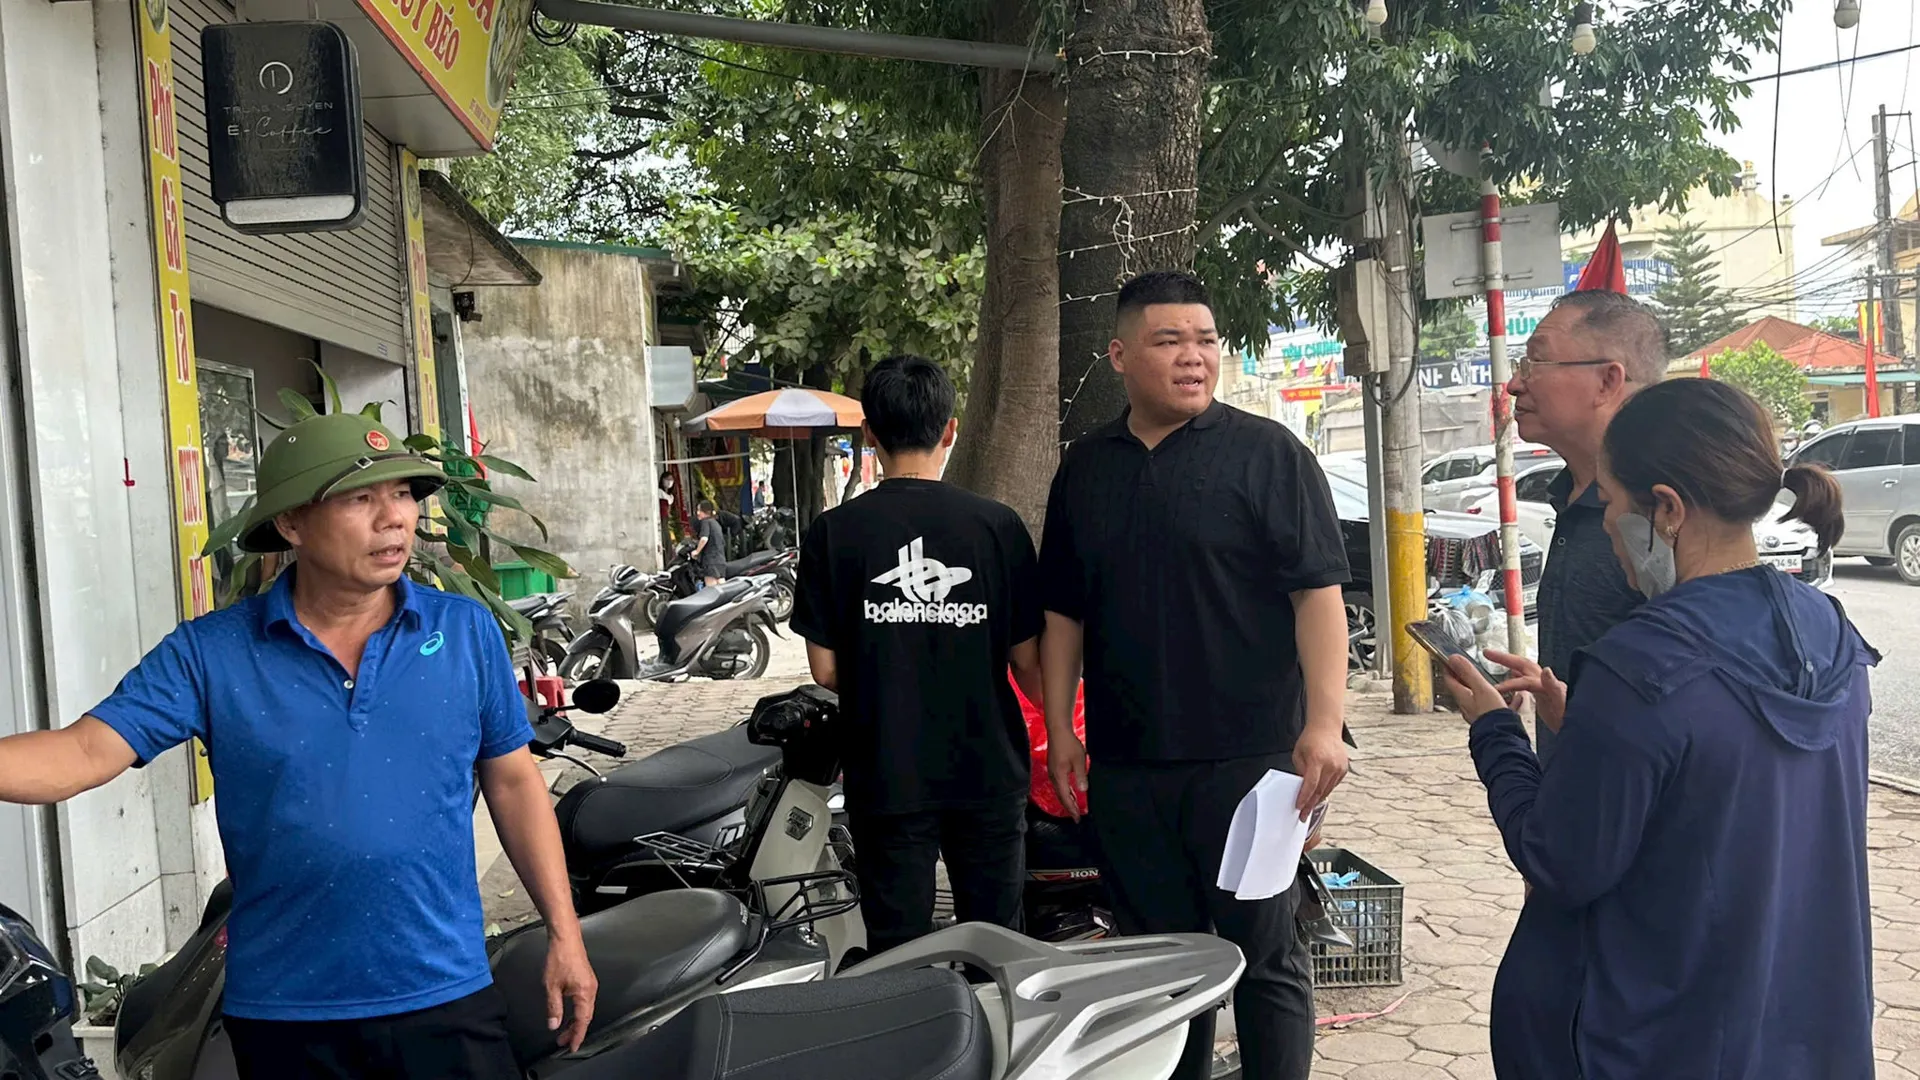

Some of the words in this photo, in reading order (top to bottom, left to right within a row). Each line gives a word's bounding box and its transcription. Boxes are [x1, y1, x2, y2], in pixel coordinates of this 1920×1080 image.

[424, 1, 460, 71] BÉO
[162, 175, 182, 272] Gà
[169, 289, 190, 385] Ta
[1470, 364, 1492, 384] TH
[864, 598, 988, 627] balenciaga
[1070, 869, 1099, 878] HON
